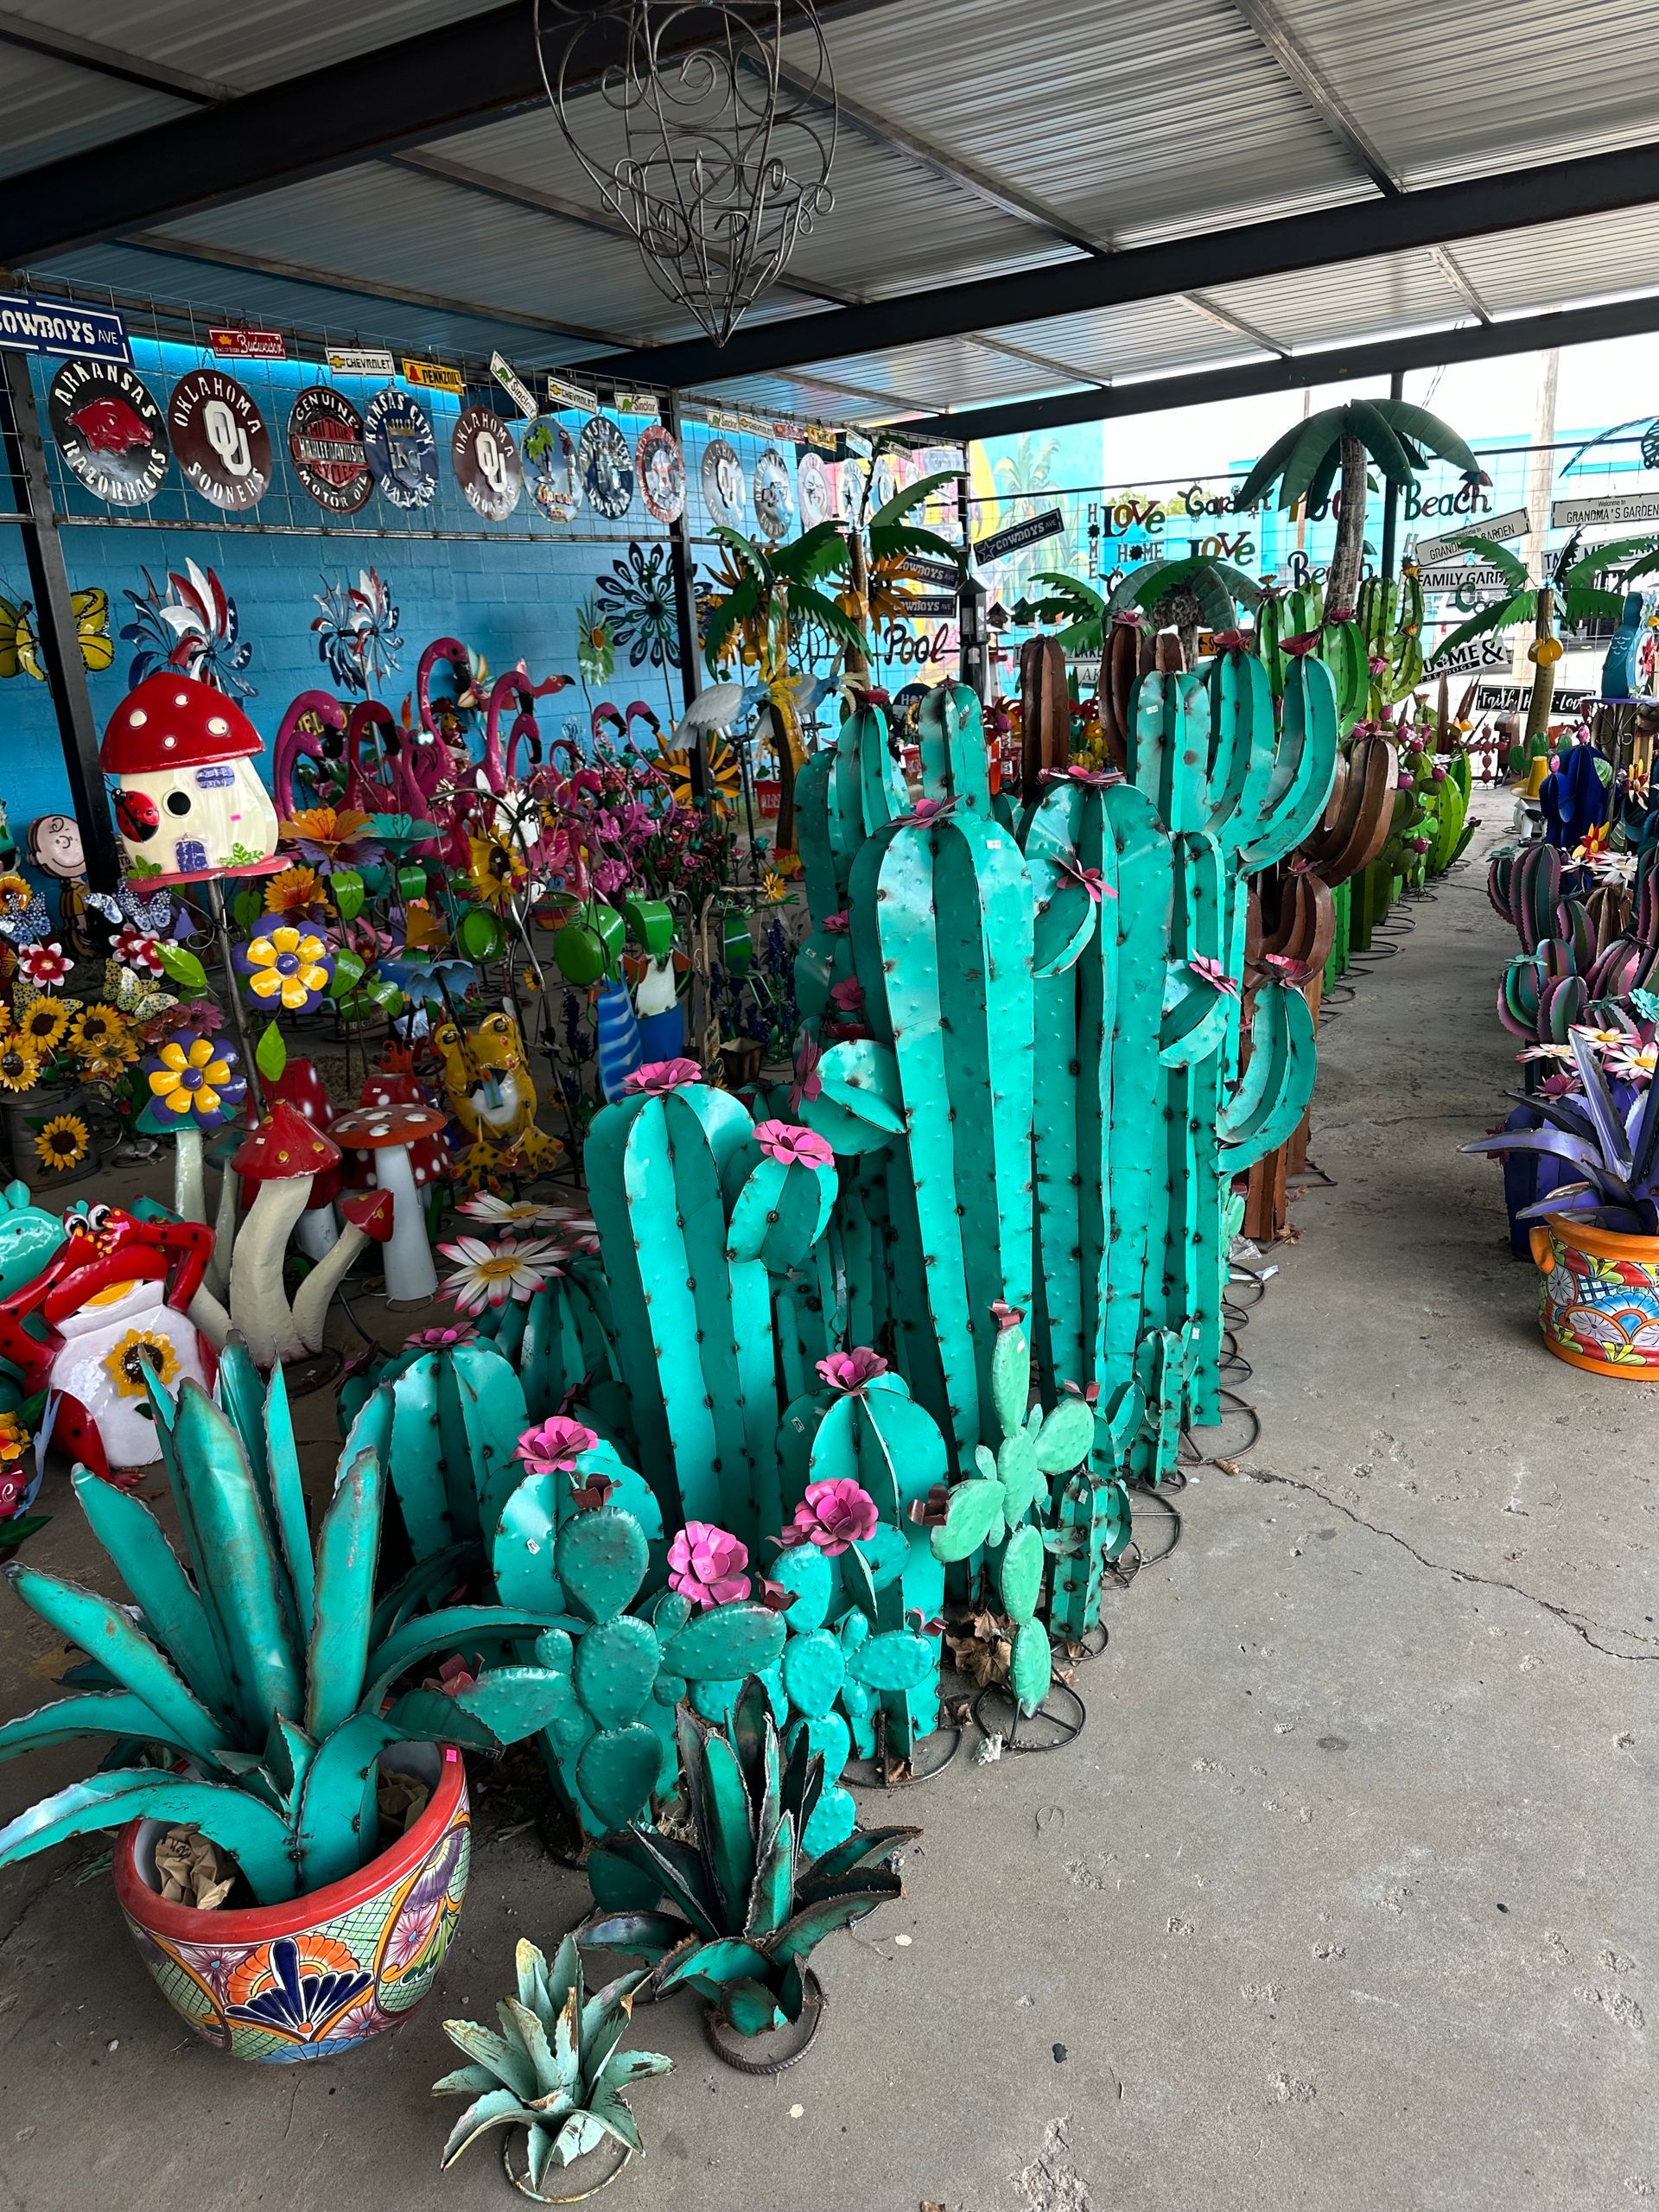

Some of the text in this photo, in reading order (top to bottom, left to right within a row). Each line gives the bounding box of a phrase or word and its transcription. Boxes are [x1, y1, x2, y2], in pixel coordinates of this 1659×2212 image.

[0, 309, 119, 346] OWBOYS AVE
[237, 334, 283, 354] Budweiser
[345, 357, 391, 370] CHEVROLET
[422, 369, 460, 386] PENNZOIL
[54, 360, 157, 418] ARKANSAS
[174, 376, 262, 435] OKLAHOMA
[510, 381, 537, 415] Sinclair
[561, 389, 596, 410] CHEVROLET
[634, 397, 657, 413] Sinclair
[296, 392, 358, 429] GENUINE
[365, 391, 435, 445] KANSAS CITY
[454, 412, 515, 458] OKLAHOMA
[62, 439, 167, 501] RAZORBACKS
[188, 461, 264, 505] SOONERS
[299, 469, 367, 508] MOTOR OIL
[1398, 479, 1493, 521] Beach
[1623, 505, 1659, 518] GARDEN
[995, 522, 1046, 550] COWBOYS
[1417, 572, 1463, 587] FAMILY
[884, 623, 949, 665] Pool
[1420, 673, 1440, 683] THE
